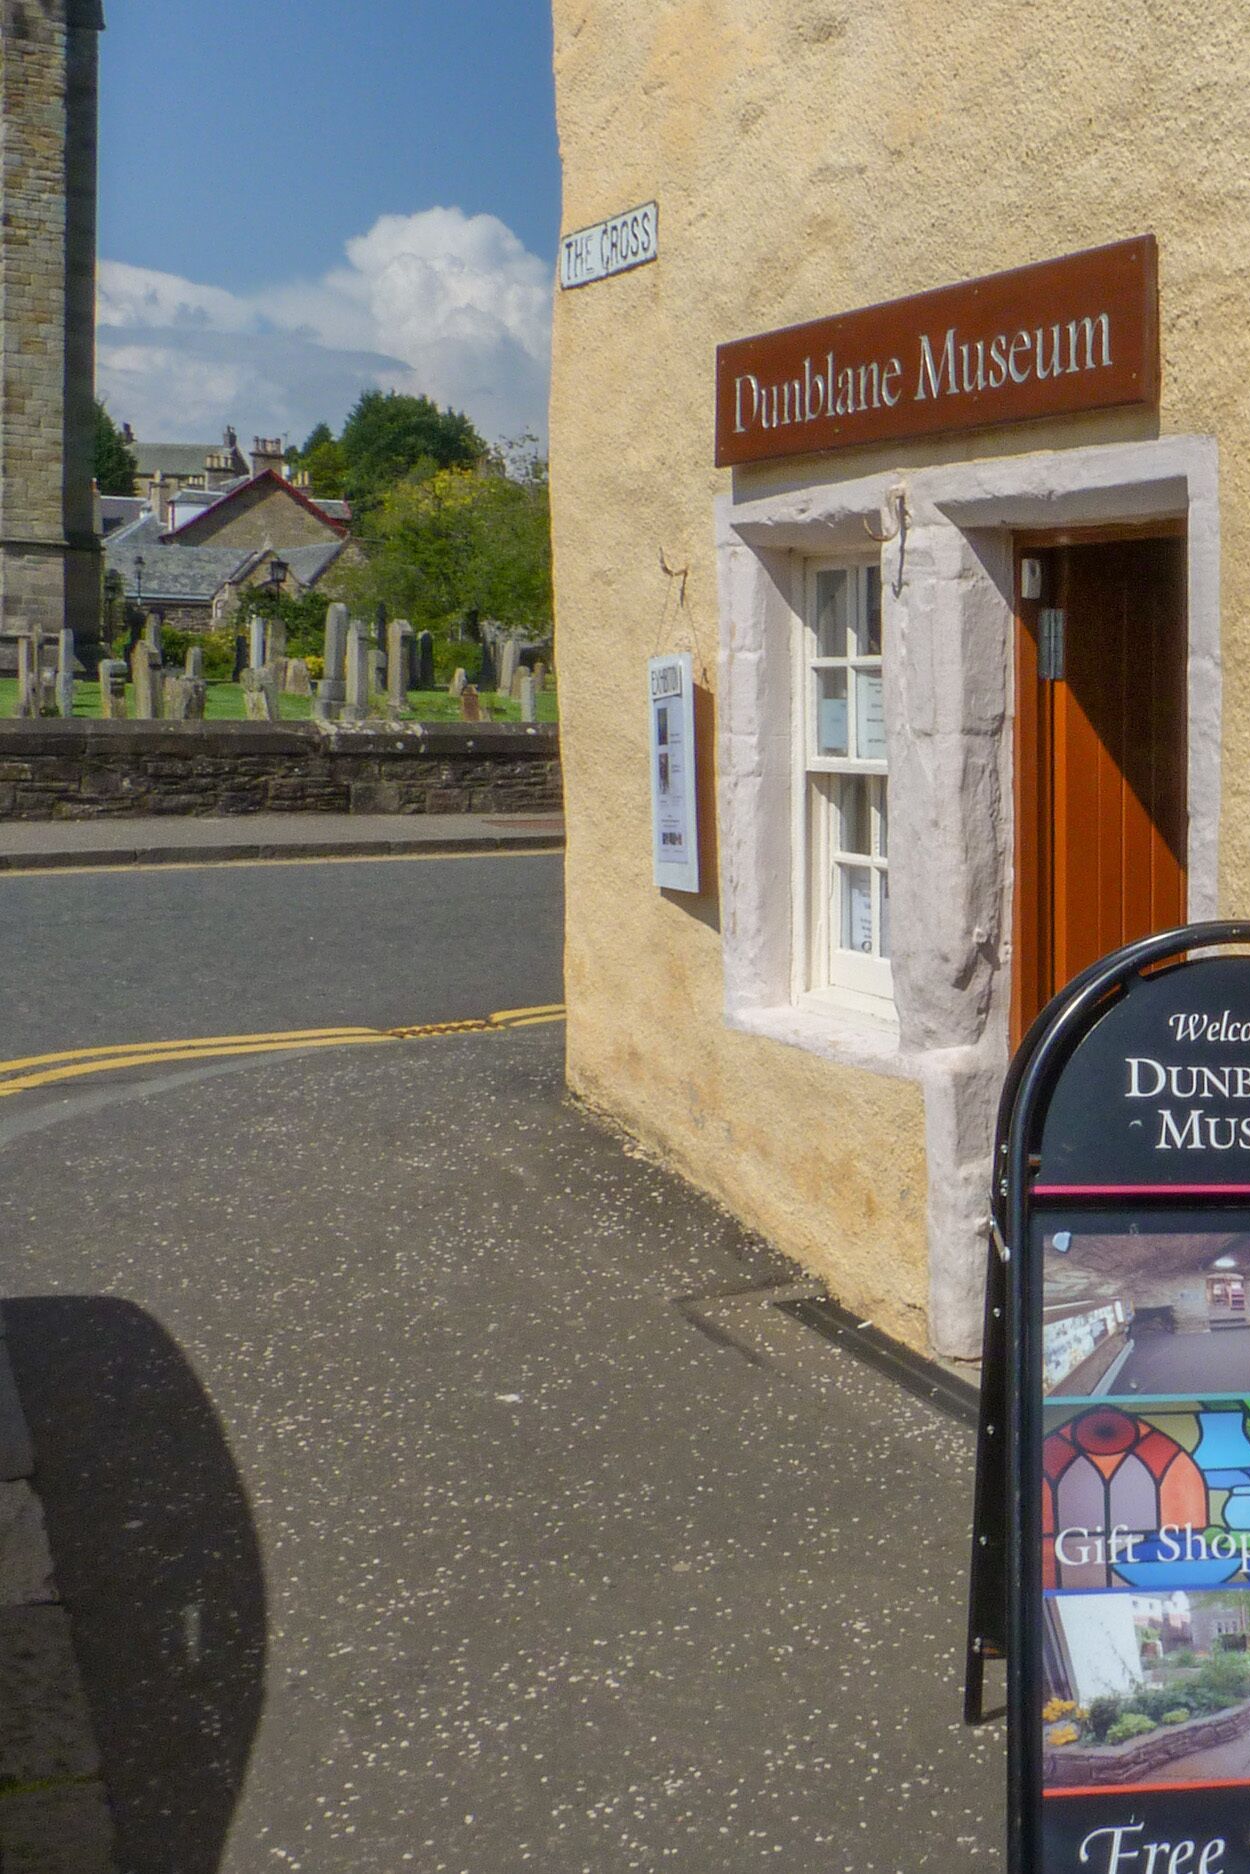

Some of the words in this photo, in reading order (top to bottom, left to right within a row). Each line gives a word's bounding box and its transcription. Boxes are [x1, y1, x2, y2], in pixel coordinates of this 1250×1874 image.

[565, 234, 594, 281] THE
[600, 212, 651, 267] CROSS
[733, 351, 903, 433] Dunblane
[914, 312, 1113, 399] Museum
[1054, 1524, 1143, 1566] Gift
[1079, 1820, 1226, 1874] Free
